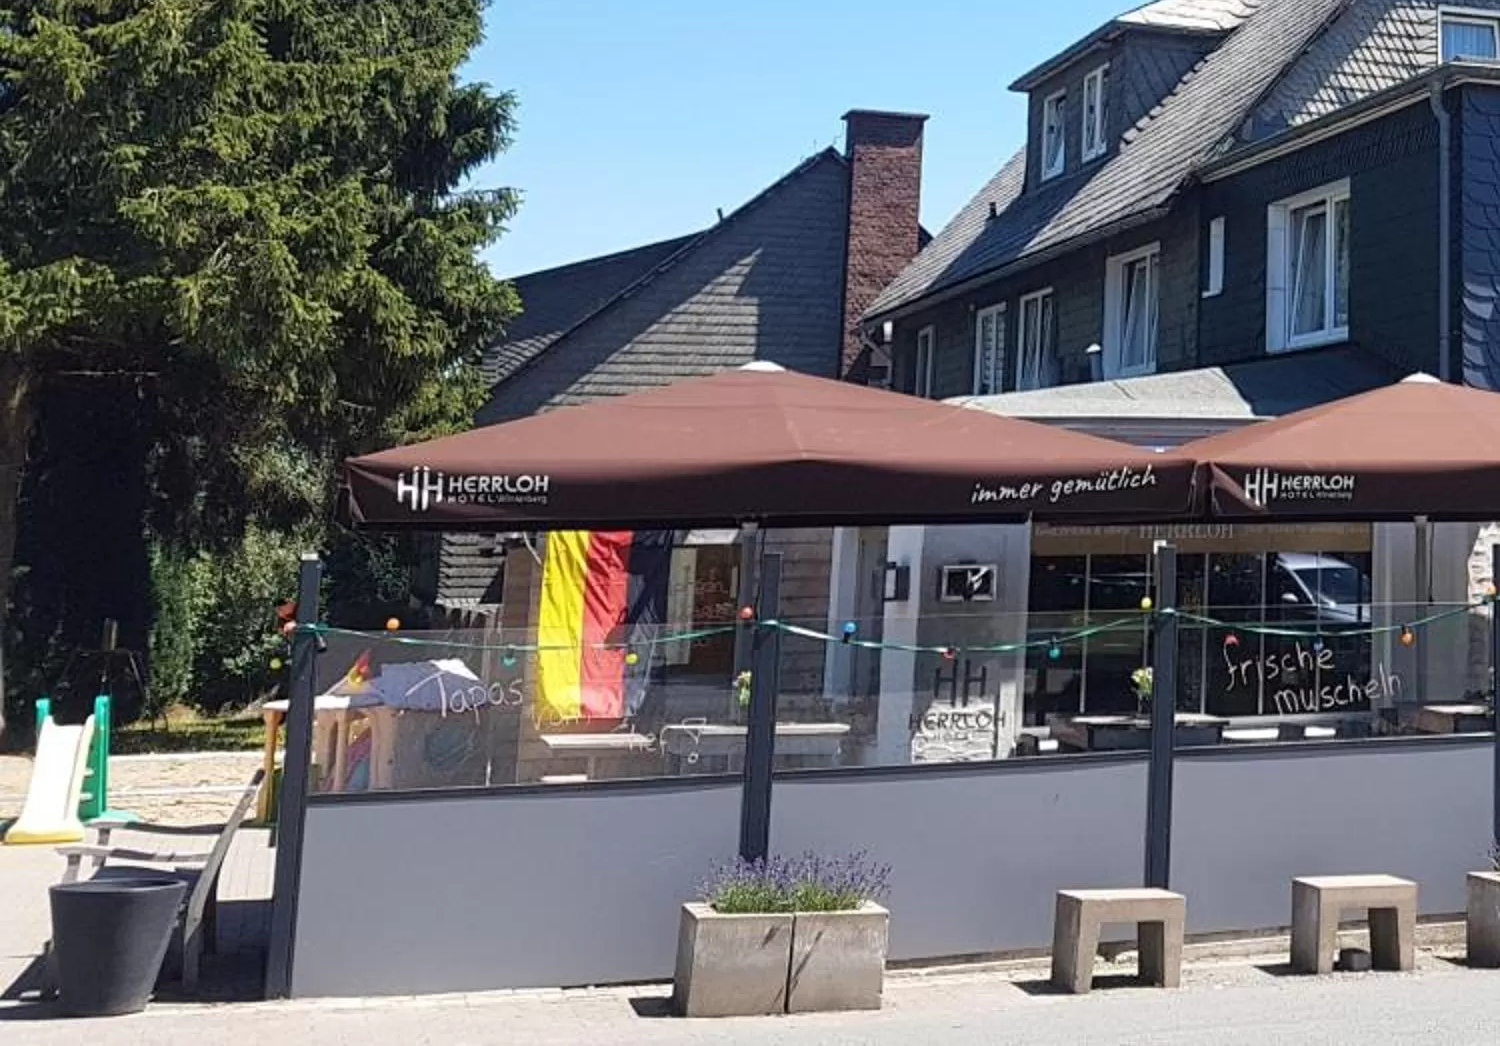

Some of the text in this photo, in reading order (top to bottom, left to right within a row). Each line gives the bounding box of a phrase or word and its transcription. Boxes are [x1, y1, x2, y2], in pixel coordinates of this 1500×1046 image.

[449, 475, 549, 493] HERRLOH
[971, 464, 1157, 504] immer gemütlich
[1281, 475, 1355, 490] HERRLOH
[1223, 641, 1335, 691] frische
[405, 669, 523, 725] Tapas
